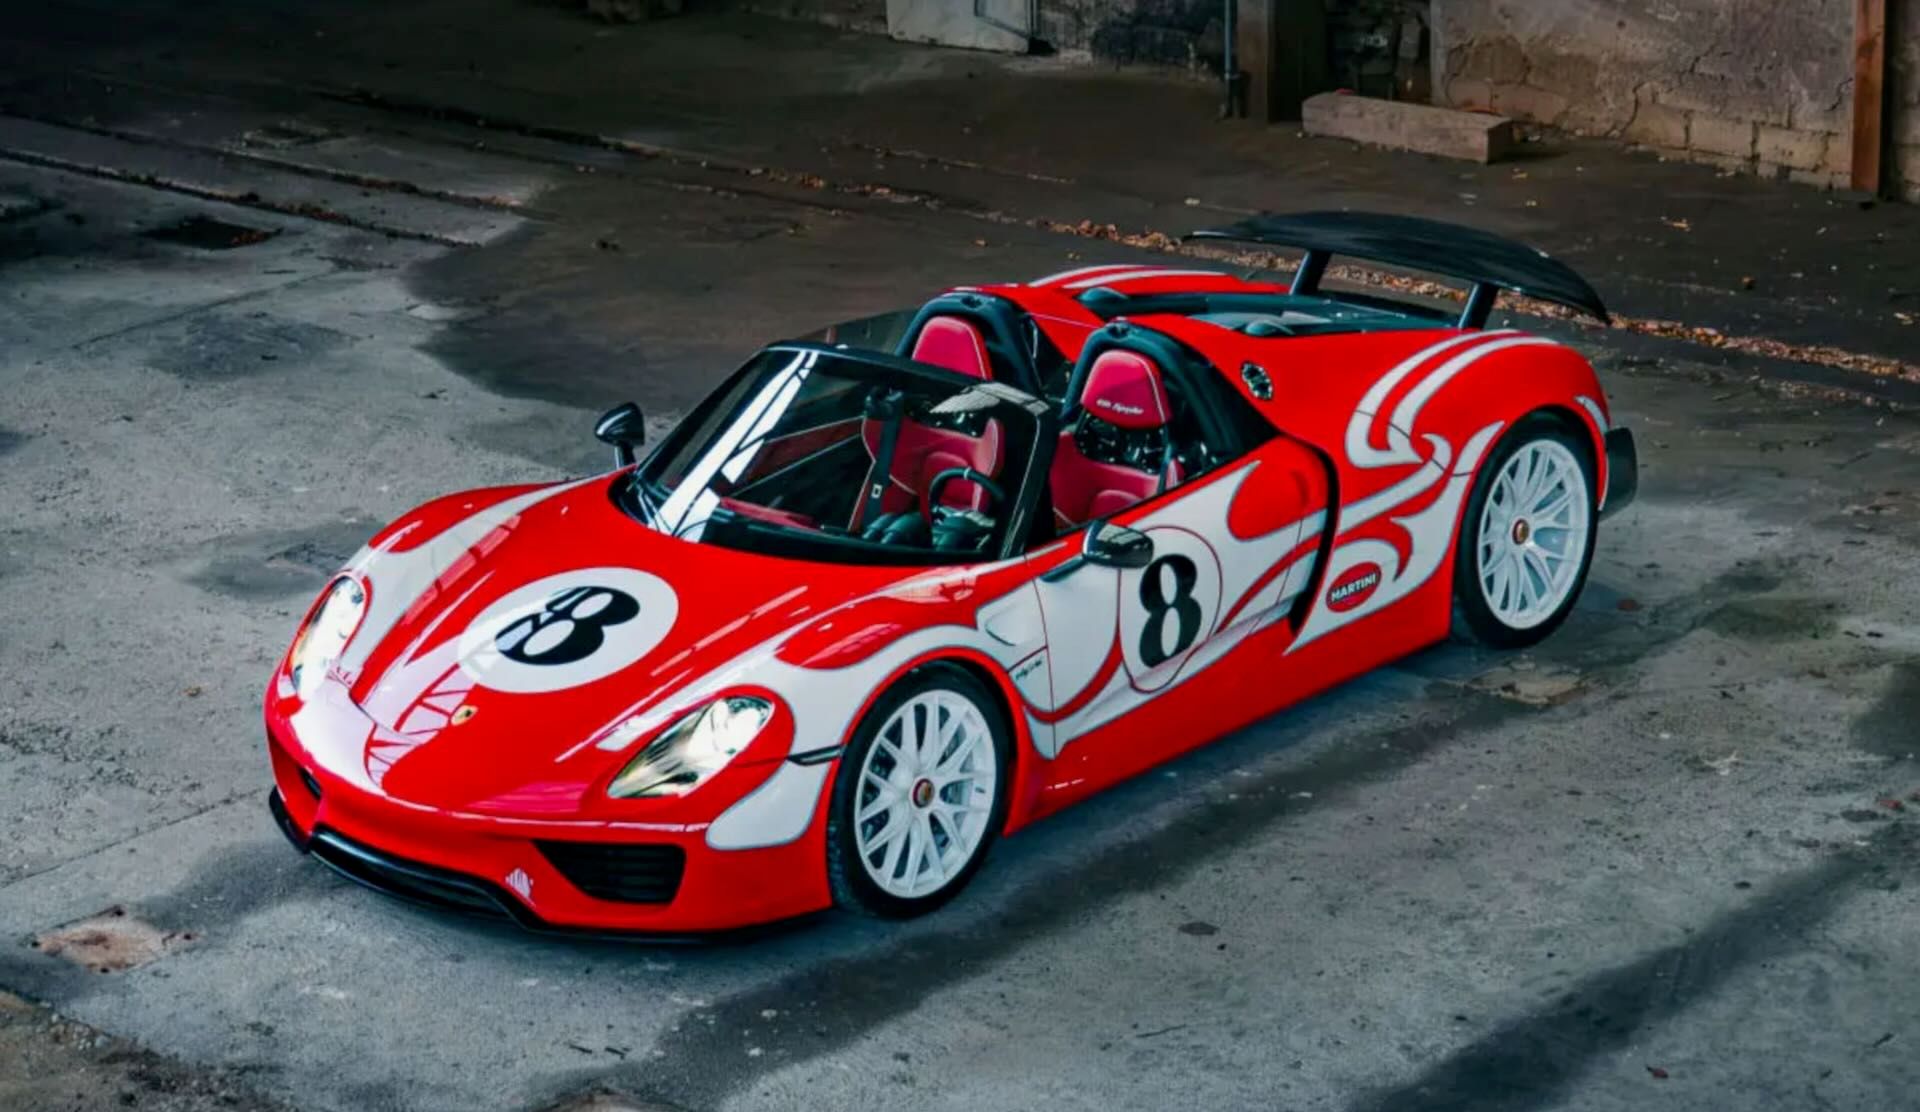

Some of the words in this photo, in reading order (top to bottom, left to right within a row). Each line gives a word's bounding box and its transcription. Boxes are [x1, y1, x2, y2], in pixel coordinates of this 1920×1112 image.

[494, 586, 640, 666] 8
[1139, 553, 1202, 669] 8
[1331, 573, 1377, 602] MARTINI
